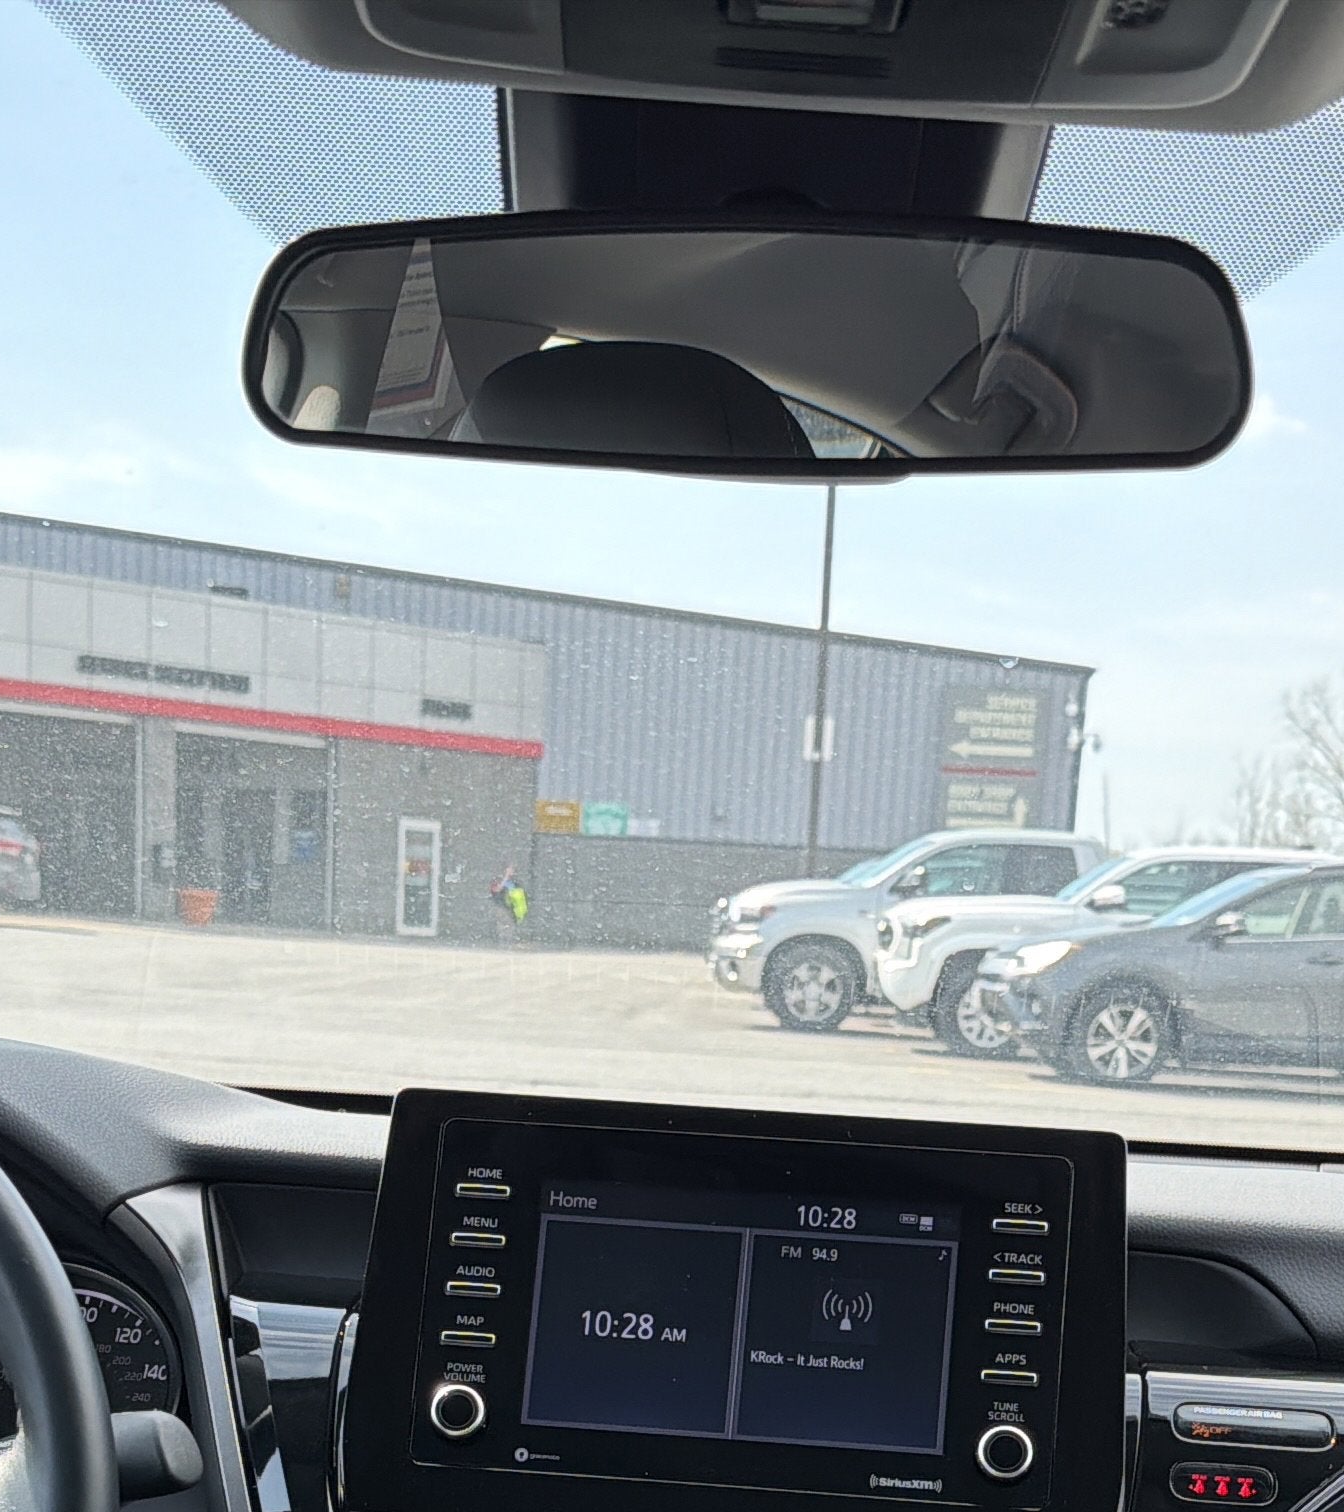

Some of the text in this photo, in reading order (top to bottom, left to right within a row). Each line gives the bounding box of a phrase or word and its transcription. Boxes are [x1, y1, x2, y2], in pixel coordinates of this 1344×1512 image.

[467, 1167, 503, 1180] HOME
[549, 1190, 598, 1210] Home
[462, 1216, 499, 1228] MENU
[796, 1204, 857, 1230] 10:28
[780, 1245, 839, 1262] FM 94.9
[456, 1265, 496, 1278] AUDIO
[993, 1302, 1036, 1315] PHONE
[456, 1314, 485, 1327] MAP
[580, 1309, 687, 1343] 10:28 AM
[114, 1327, 142, 1344] 120
[750, 1350, 784, 1365] KRock
[796, 1353, 805, 1366] It
[806, 1354, 828, 1368] Just
[830, 1355, 865, 1371] Rocks!
[995, 1353, 1027, 1365] APPS
[143, 1364, 168, 1381] 140
[446, 1362, 484, 1374] POWER
[443, 1372, 487, 1384] VOLUME
[992, 1401, 1019, 1412] TUNE
[987, 1410, 1025, 1423] SCROLL
